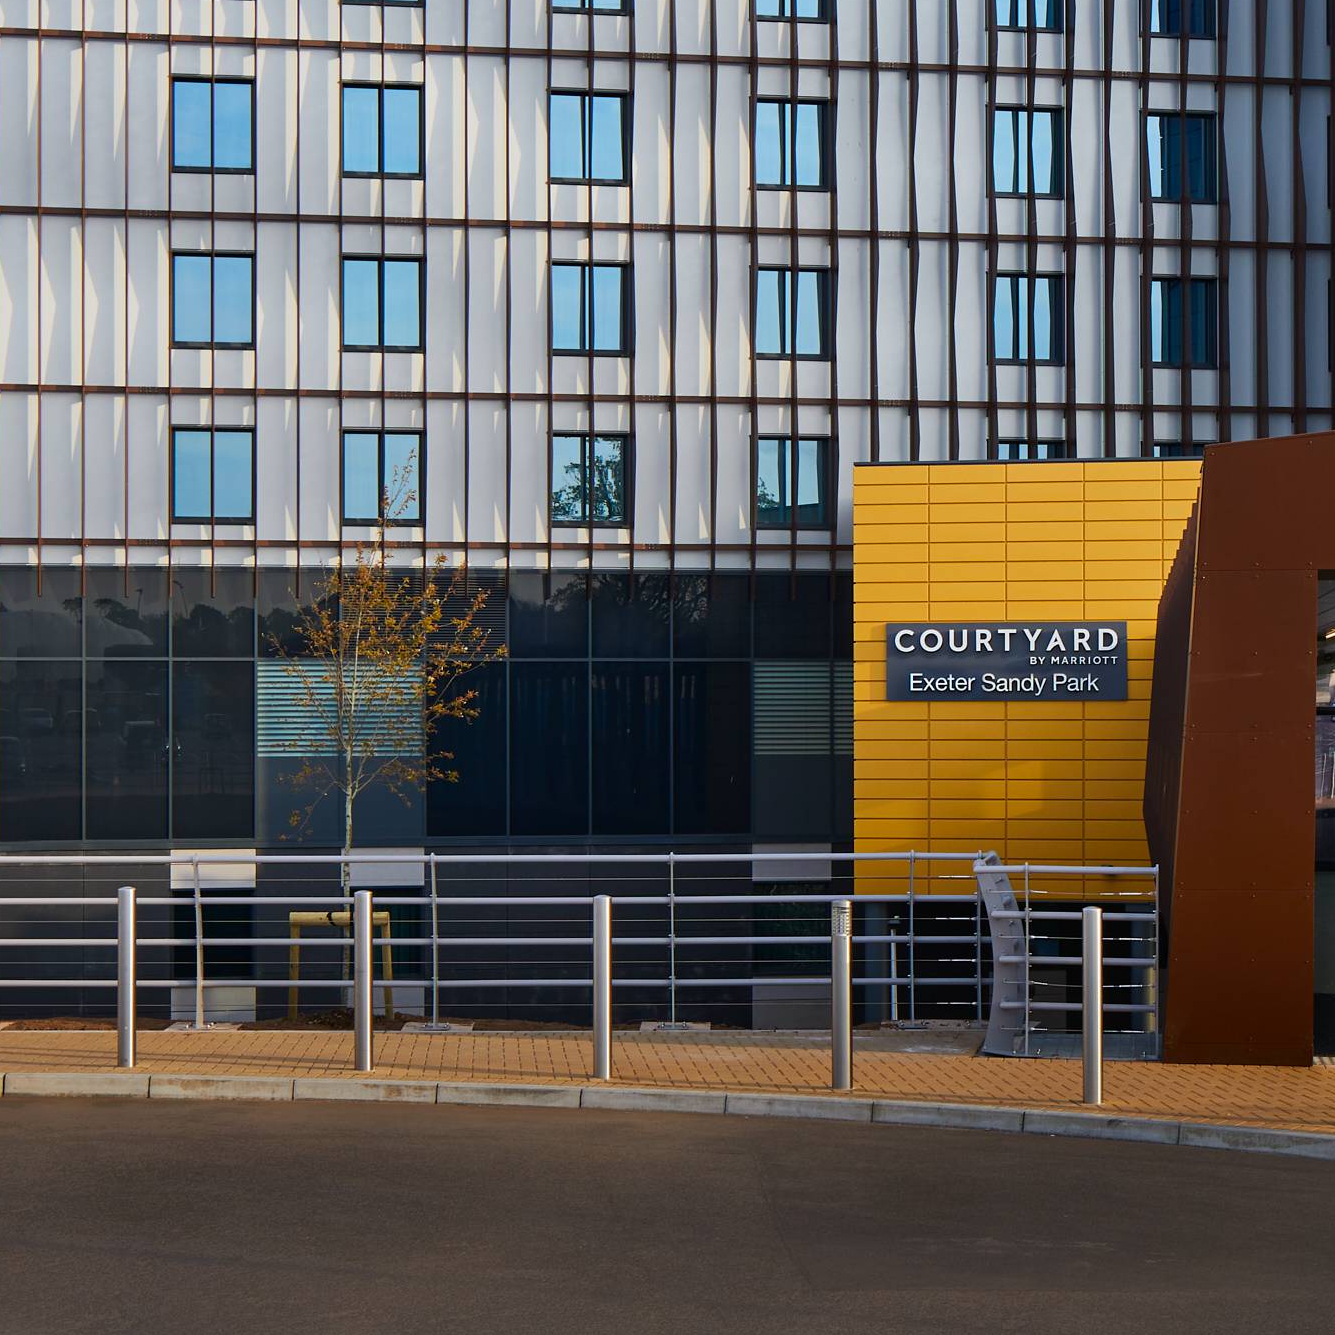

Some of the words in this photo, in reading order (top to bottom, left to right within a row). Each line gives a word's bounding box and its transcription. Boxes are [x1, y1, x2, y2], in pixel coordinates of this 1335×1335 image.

[894, 627, 1119, 653] COURTYARD
[1029, 655, 1046, 665] BY
[1050, 655, 1118, 665] MARRIOTT
[909, 672, 976, 692] Exeter
[981, 672, 1047, 696] Sandy
[1053, 672, 1099, 692] Park
